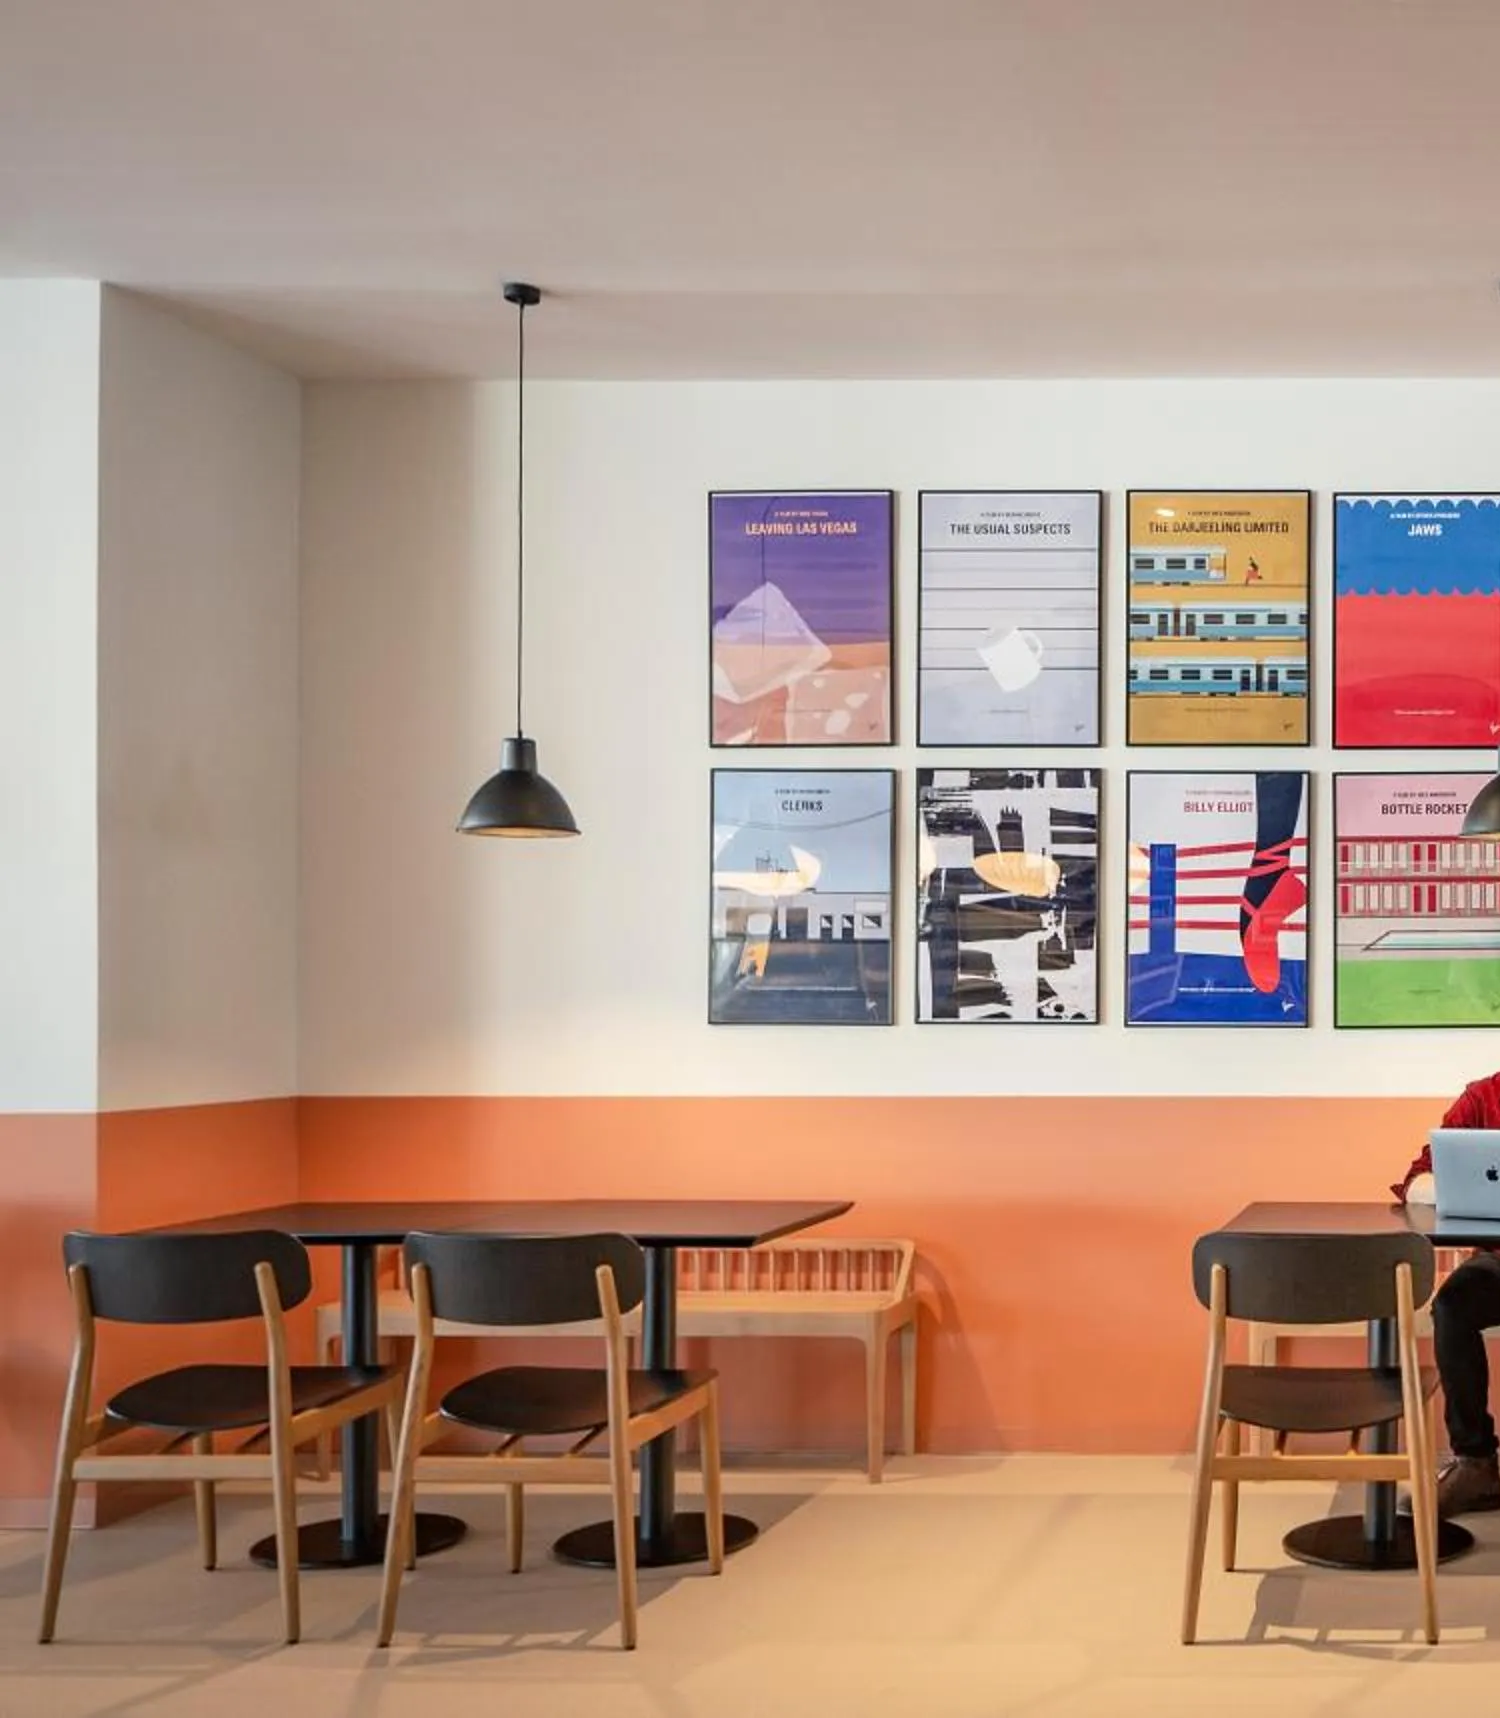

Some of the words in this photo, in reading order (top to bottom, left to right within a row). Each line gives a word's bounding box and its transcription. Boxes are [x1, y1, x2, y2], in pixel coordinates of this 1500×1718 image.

[746, 522, 793, 535] LEAVING
[796, 522, 817, 534] LAS
[820, 522, 857, 534] VEGAS
[950, 523, 971, 535] THE
[974, 523, 1010, 535] USUAL
[1013, 523, 1071, 535] SUSPECTS
[1149, 522, 1168, 533] THE
[1172, 522, 1240, 533] DARJEELING
[1244, 522, 1289, 533] LIMITED
[1408, 524, 1442, 536] JAWS
[781, 800, 823, 811] CLERKS
[1183, 802, 1215, 813] BILLY
[1217, 802, 1253, 813] ELLIOT
[1382, 804, 1422, 815] BOTTLE
[1425, 804, 1468, 815] ROCKET
